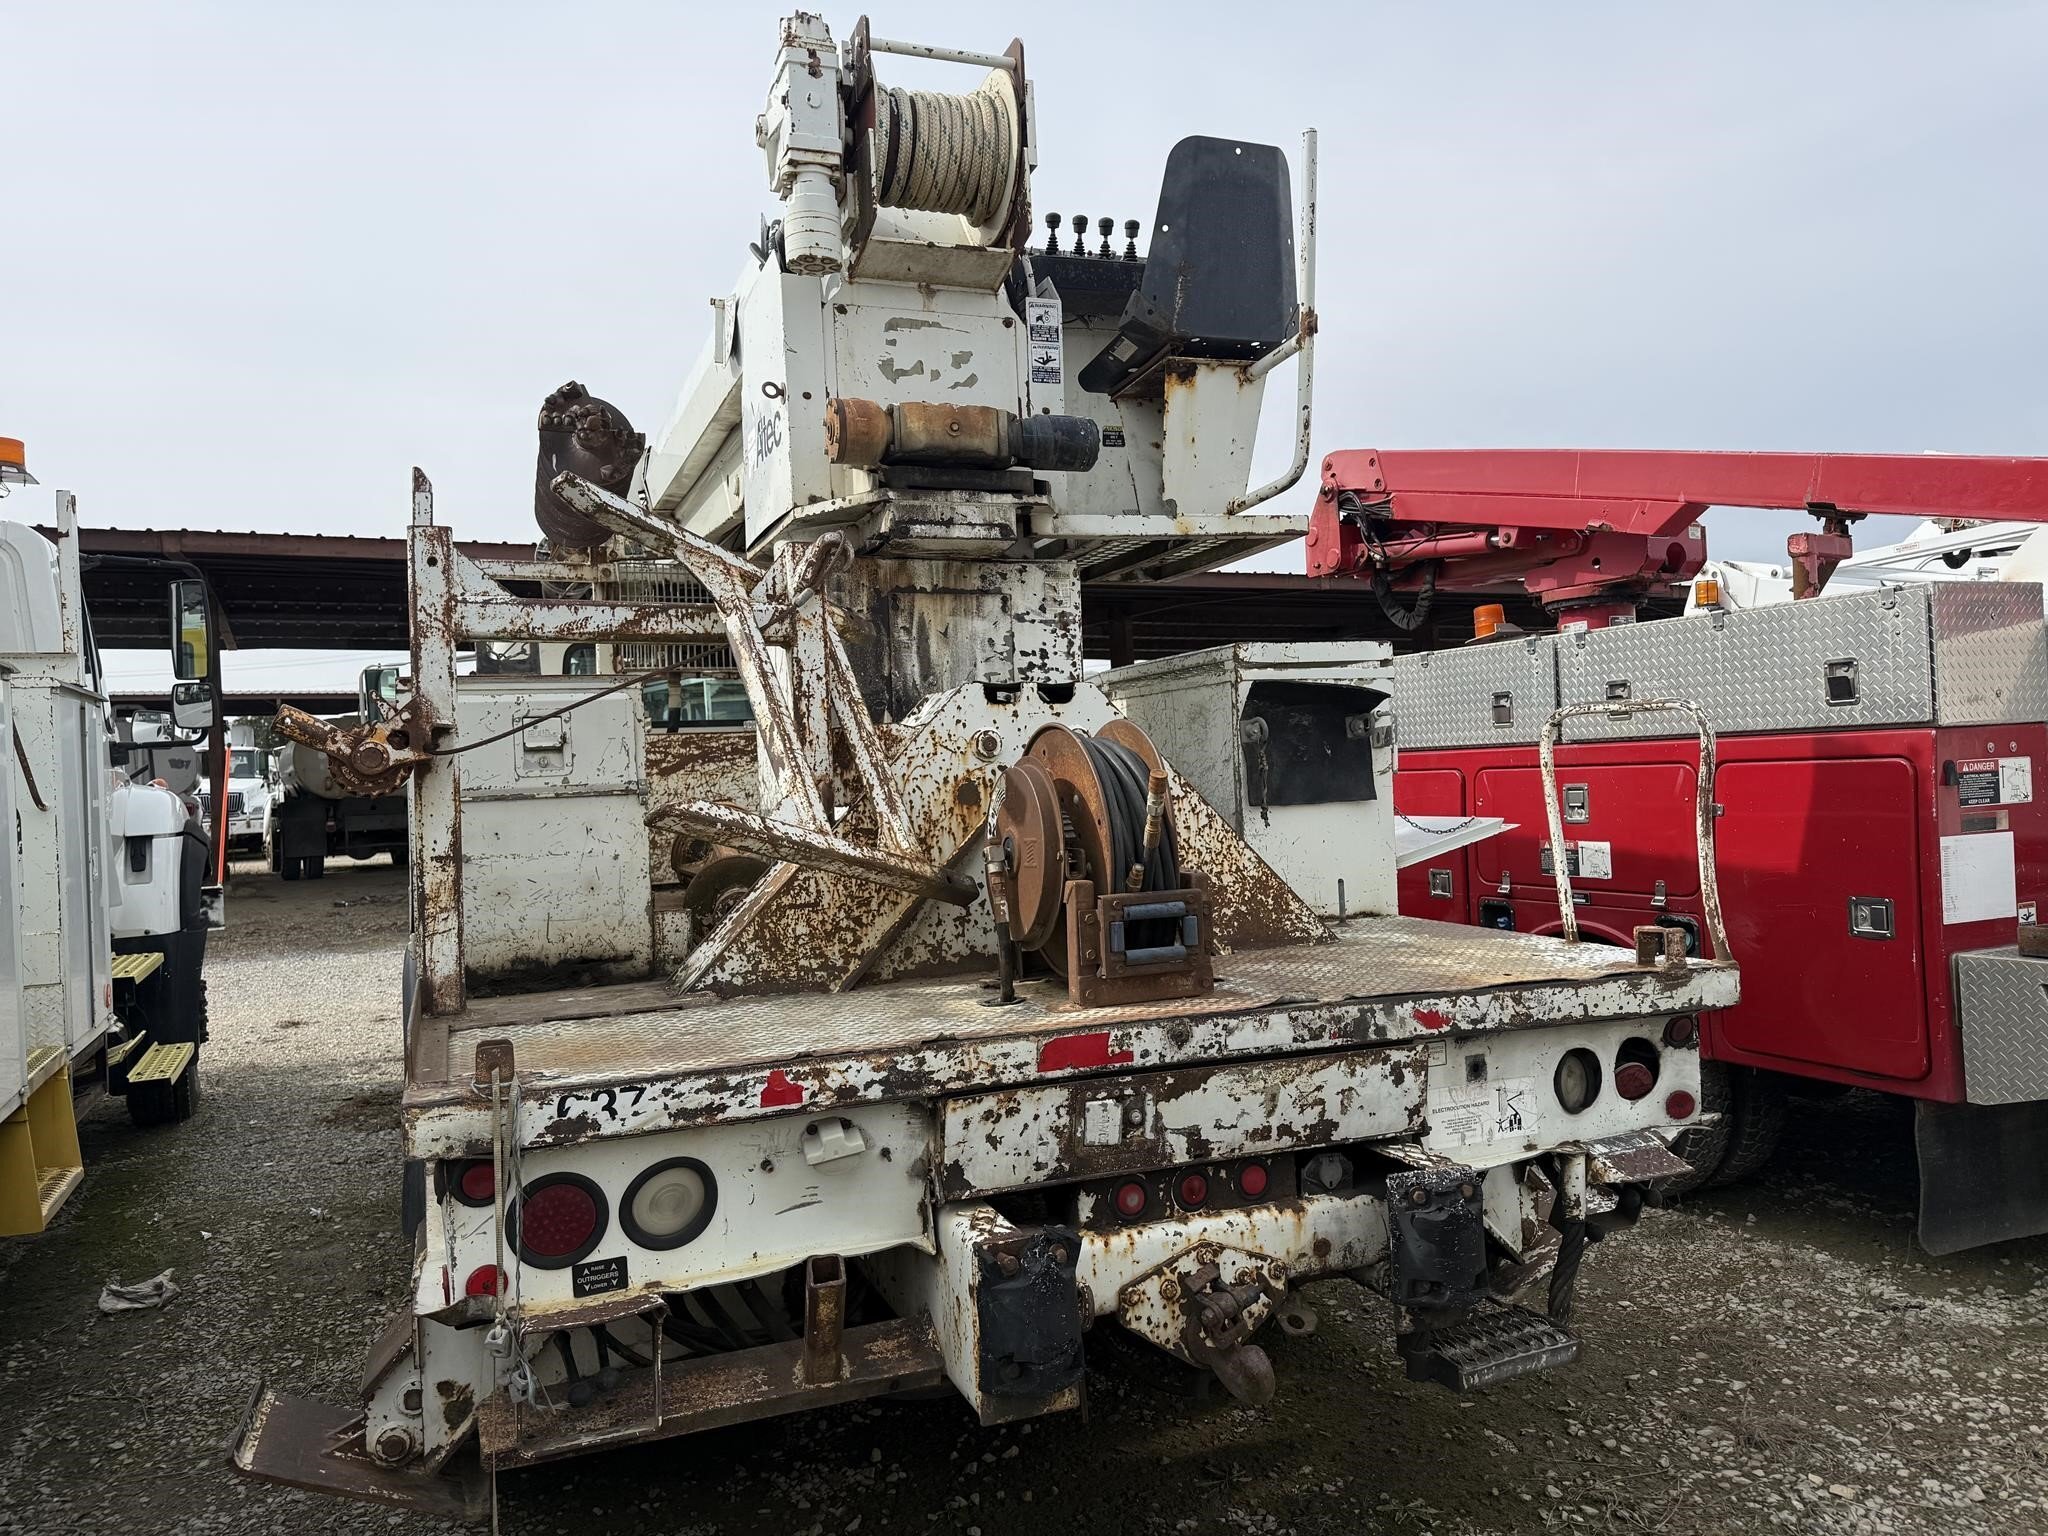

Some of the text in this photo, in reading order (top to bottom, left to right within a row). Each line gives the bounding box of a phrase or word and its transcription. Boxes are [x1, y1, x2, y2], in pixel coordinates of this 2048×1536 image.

[1969, 762, 1995, 771] DANGER
[1432, 1103, 1471, 1114] ELECTROCUTION
[577, 1270, 619, 1284] OUTRIGGERS
[590, 1282, 608, 1290] LOWER
